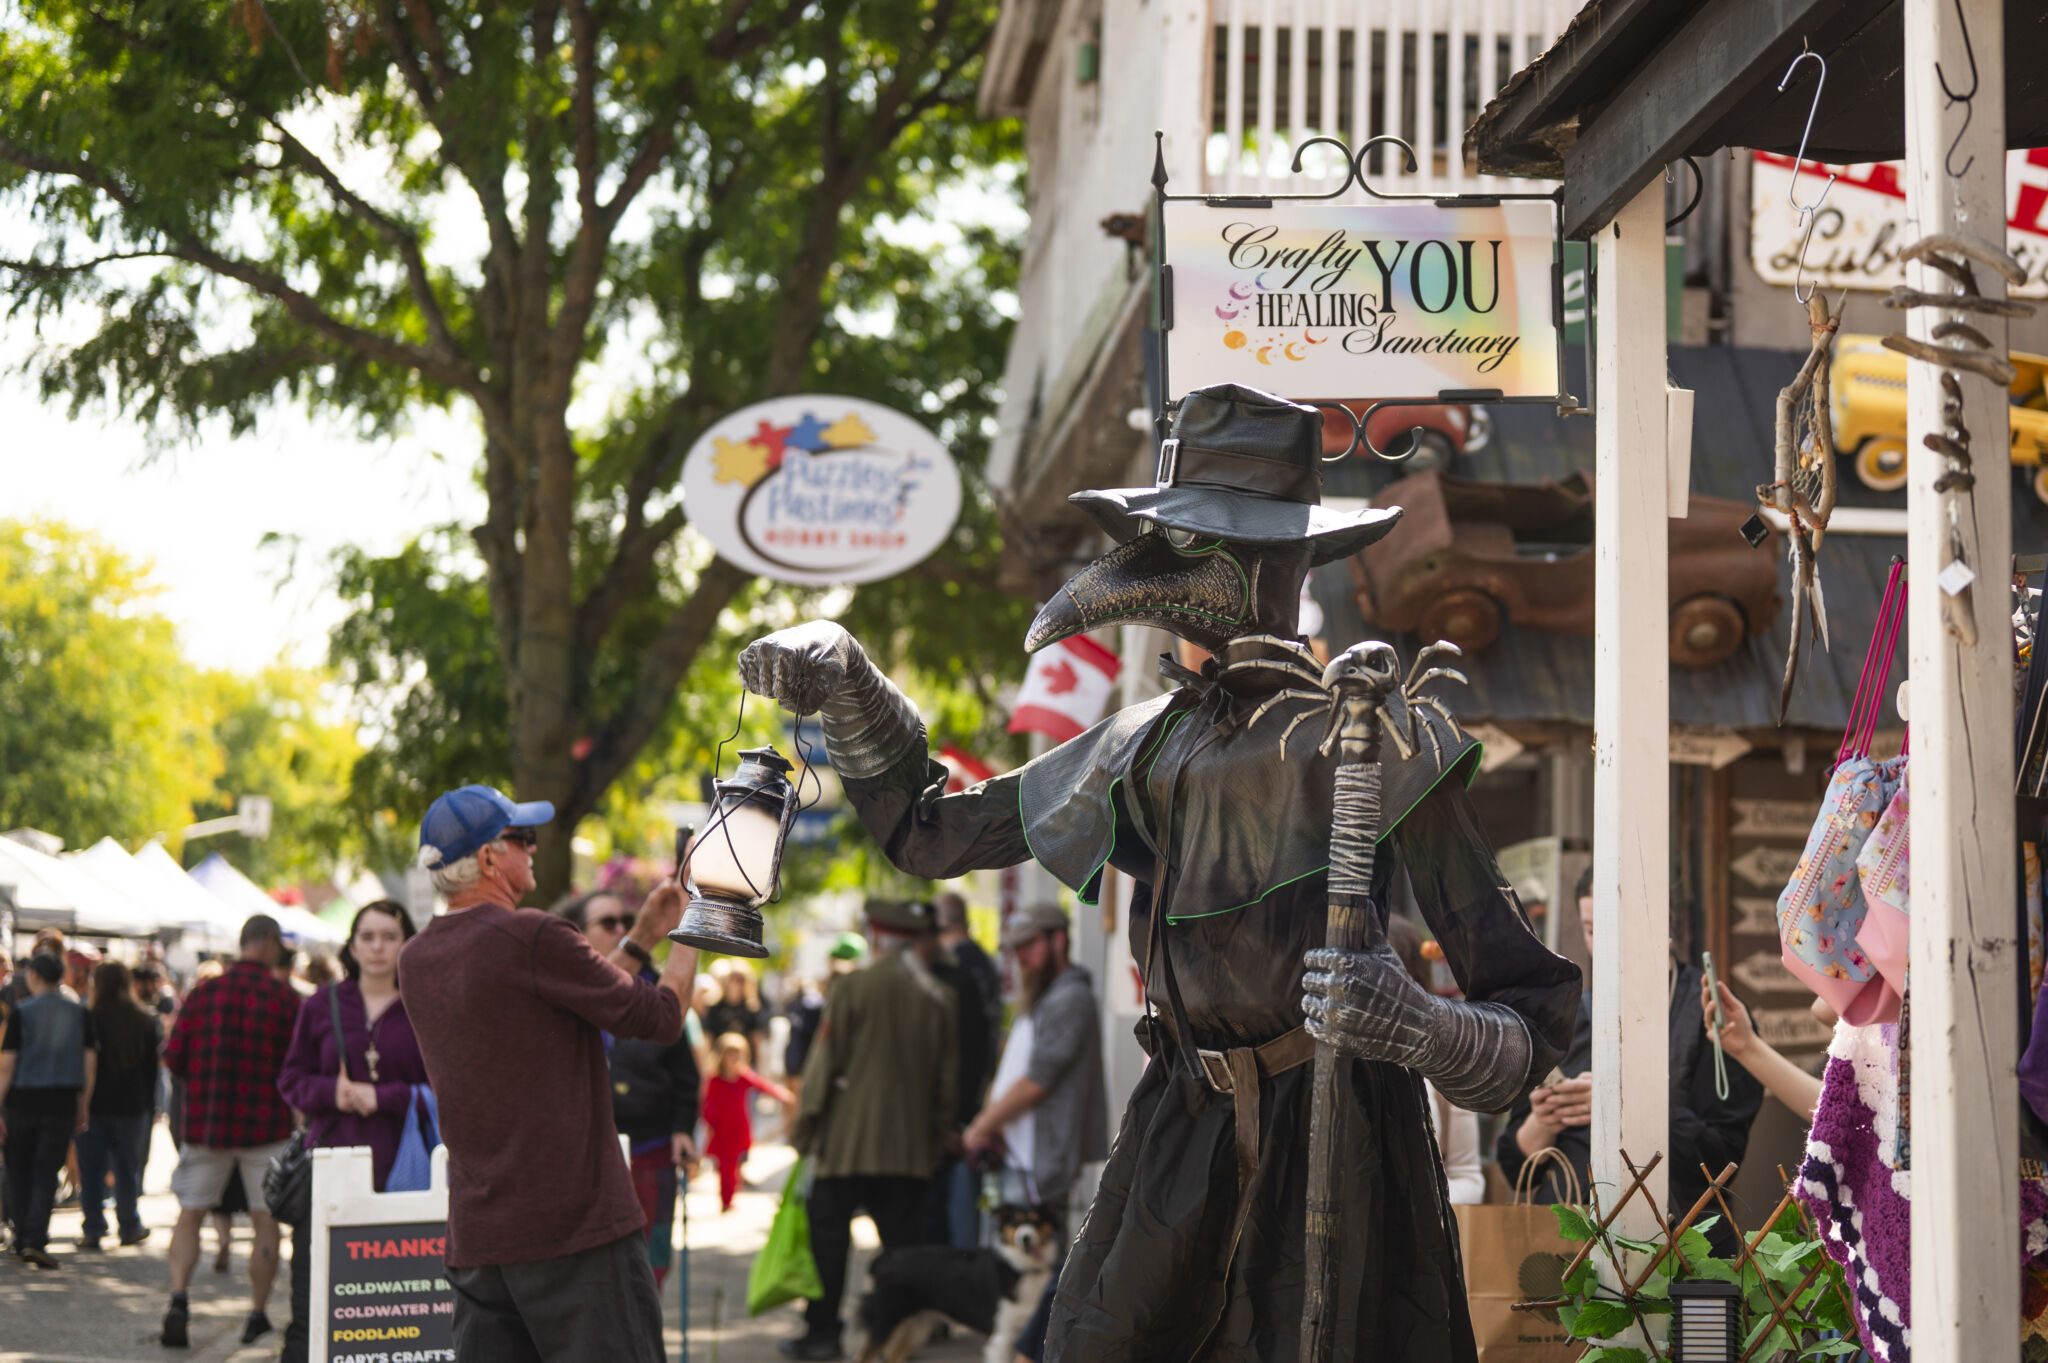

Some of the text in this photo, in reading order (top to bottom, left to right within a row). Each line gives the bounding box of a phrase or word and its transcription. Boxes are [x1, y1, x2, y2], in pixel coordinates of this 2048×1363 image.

[1221, 222, 1362, 293] Crafty
[1362, 240, 1503, 314] YOU
[1256, 293, 1377, 327] HEALING
[1341, 315, 1520, 373] Sanctuary
[334, 1279, 431, 1296] COLDWATER
[334, 1303, 430, 1319] COLDWATER
[333, 1326, 421, 1342] FOODLAND
[391, 1348, 456, 1363] CRAFT'S
